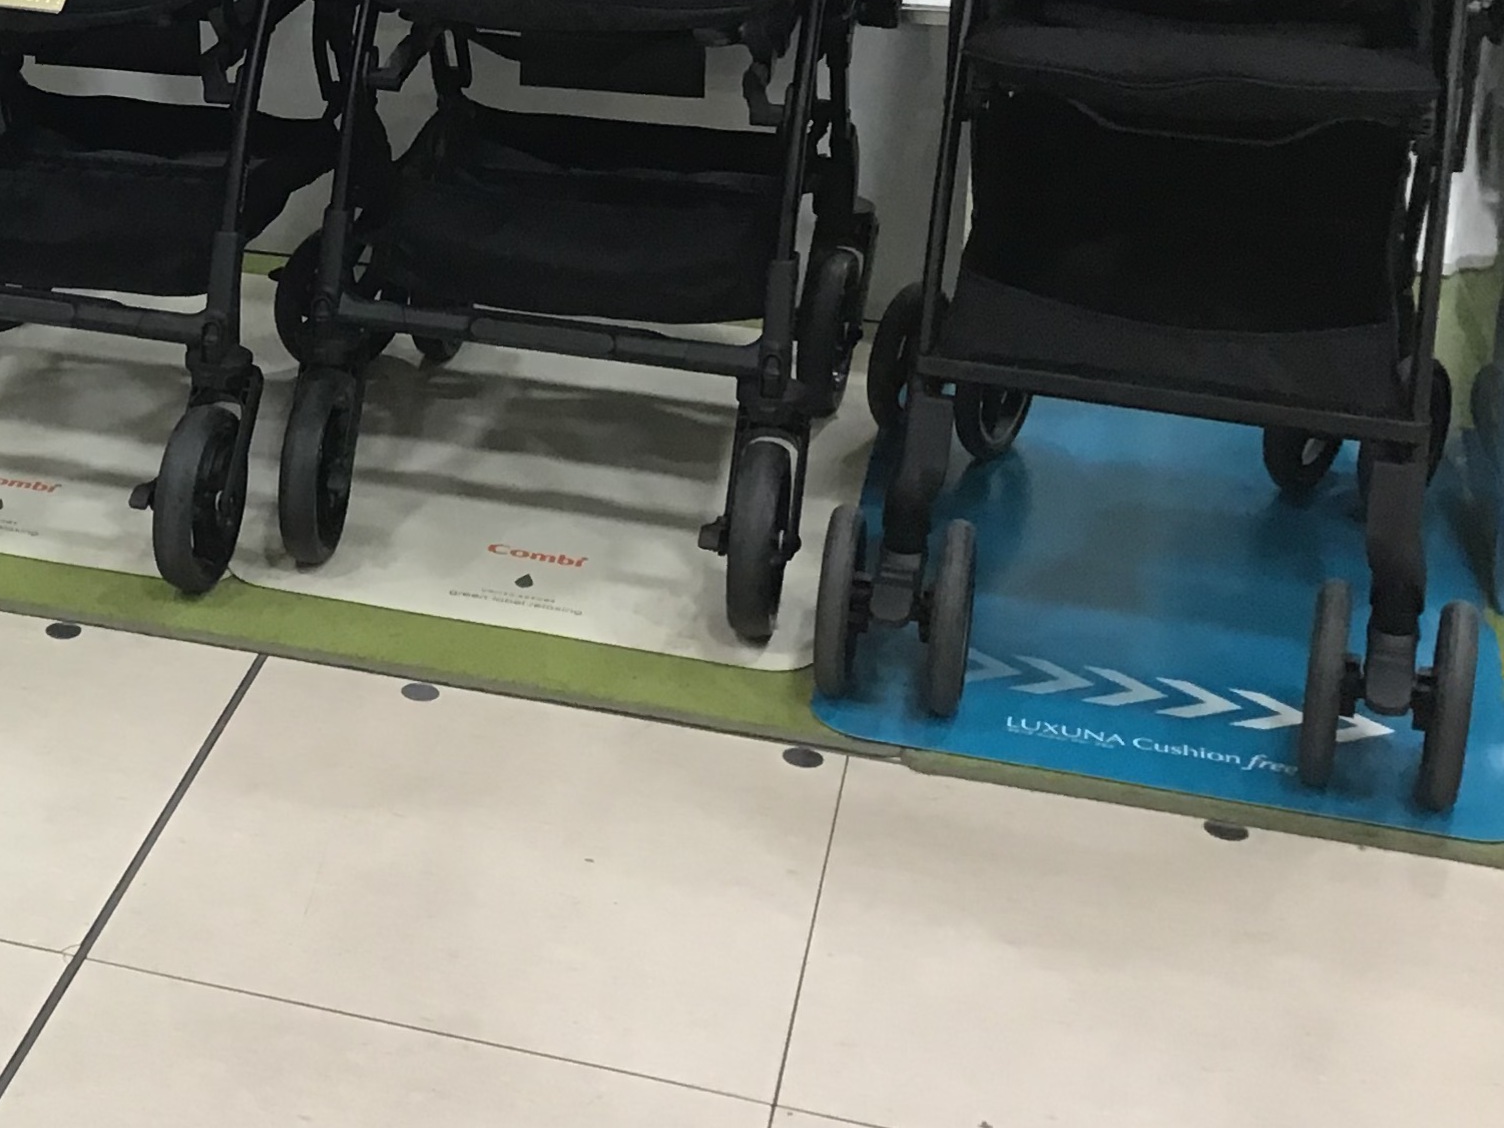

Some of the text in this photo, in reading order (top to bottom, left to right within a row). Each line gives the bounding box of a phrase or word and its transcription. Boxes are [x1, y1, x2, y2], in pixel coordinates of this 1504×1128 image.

[487, 544, 590, 568] Combi
[1005, 715, 1126, 747] LUXUNA
[1132, 736, 1242, 765] Cushion
